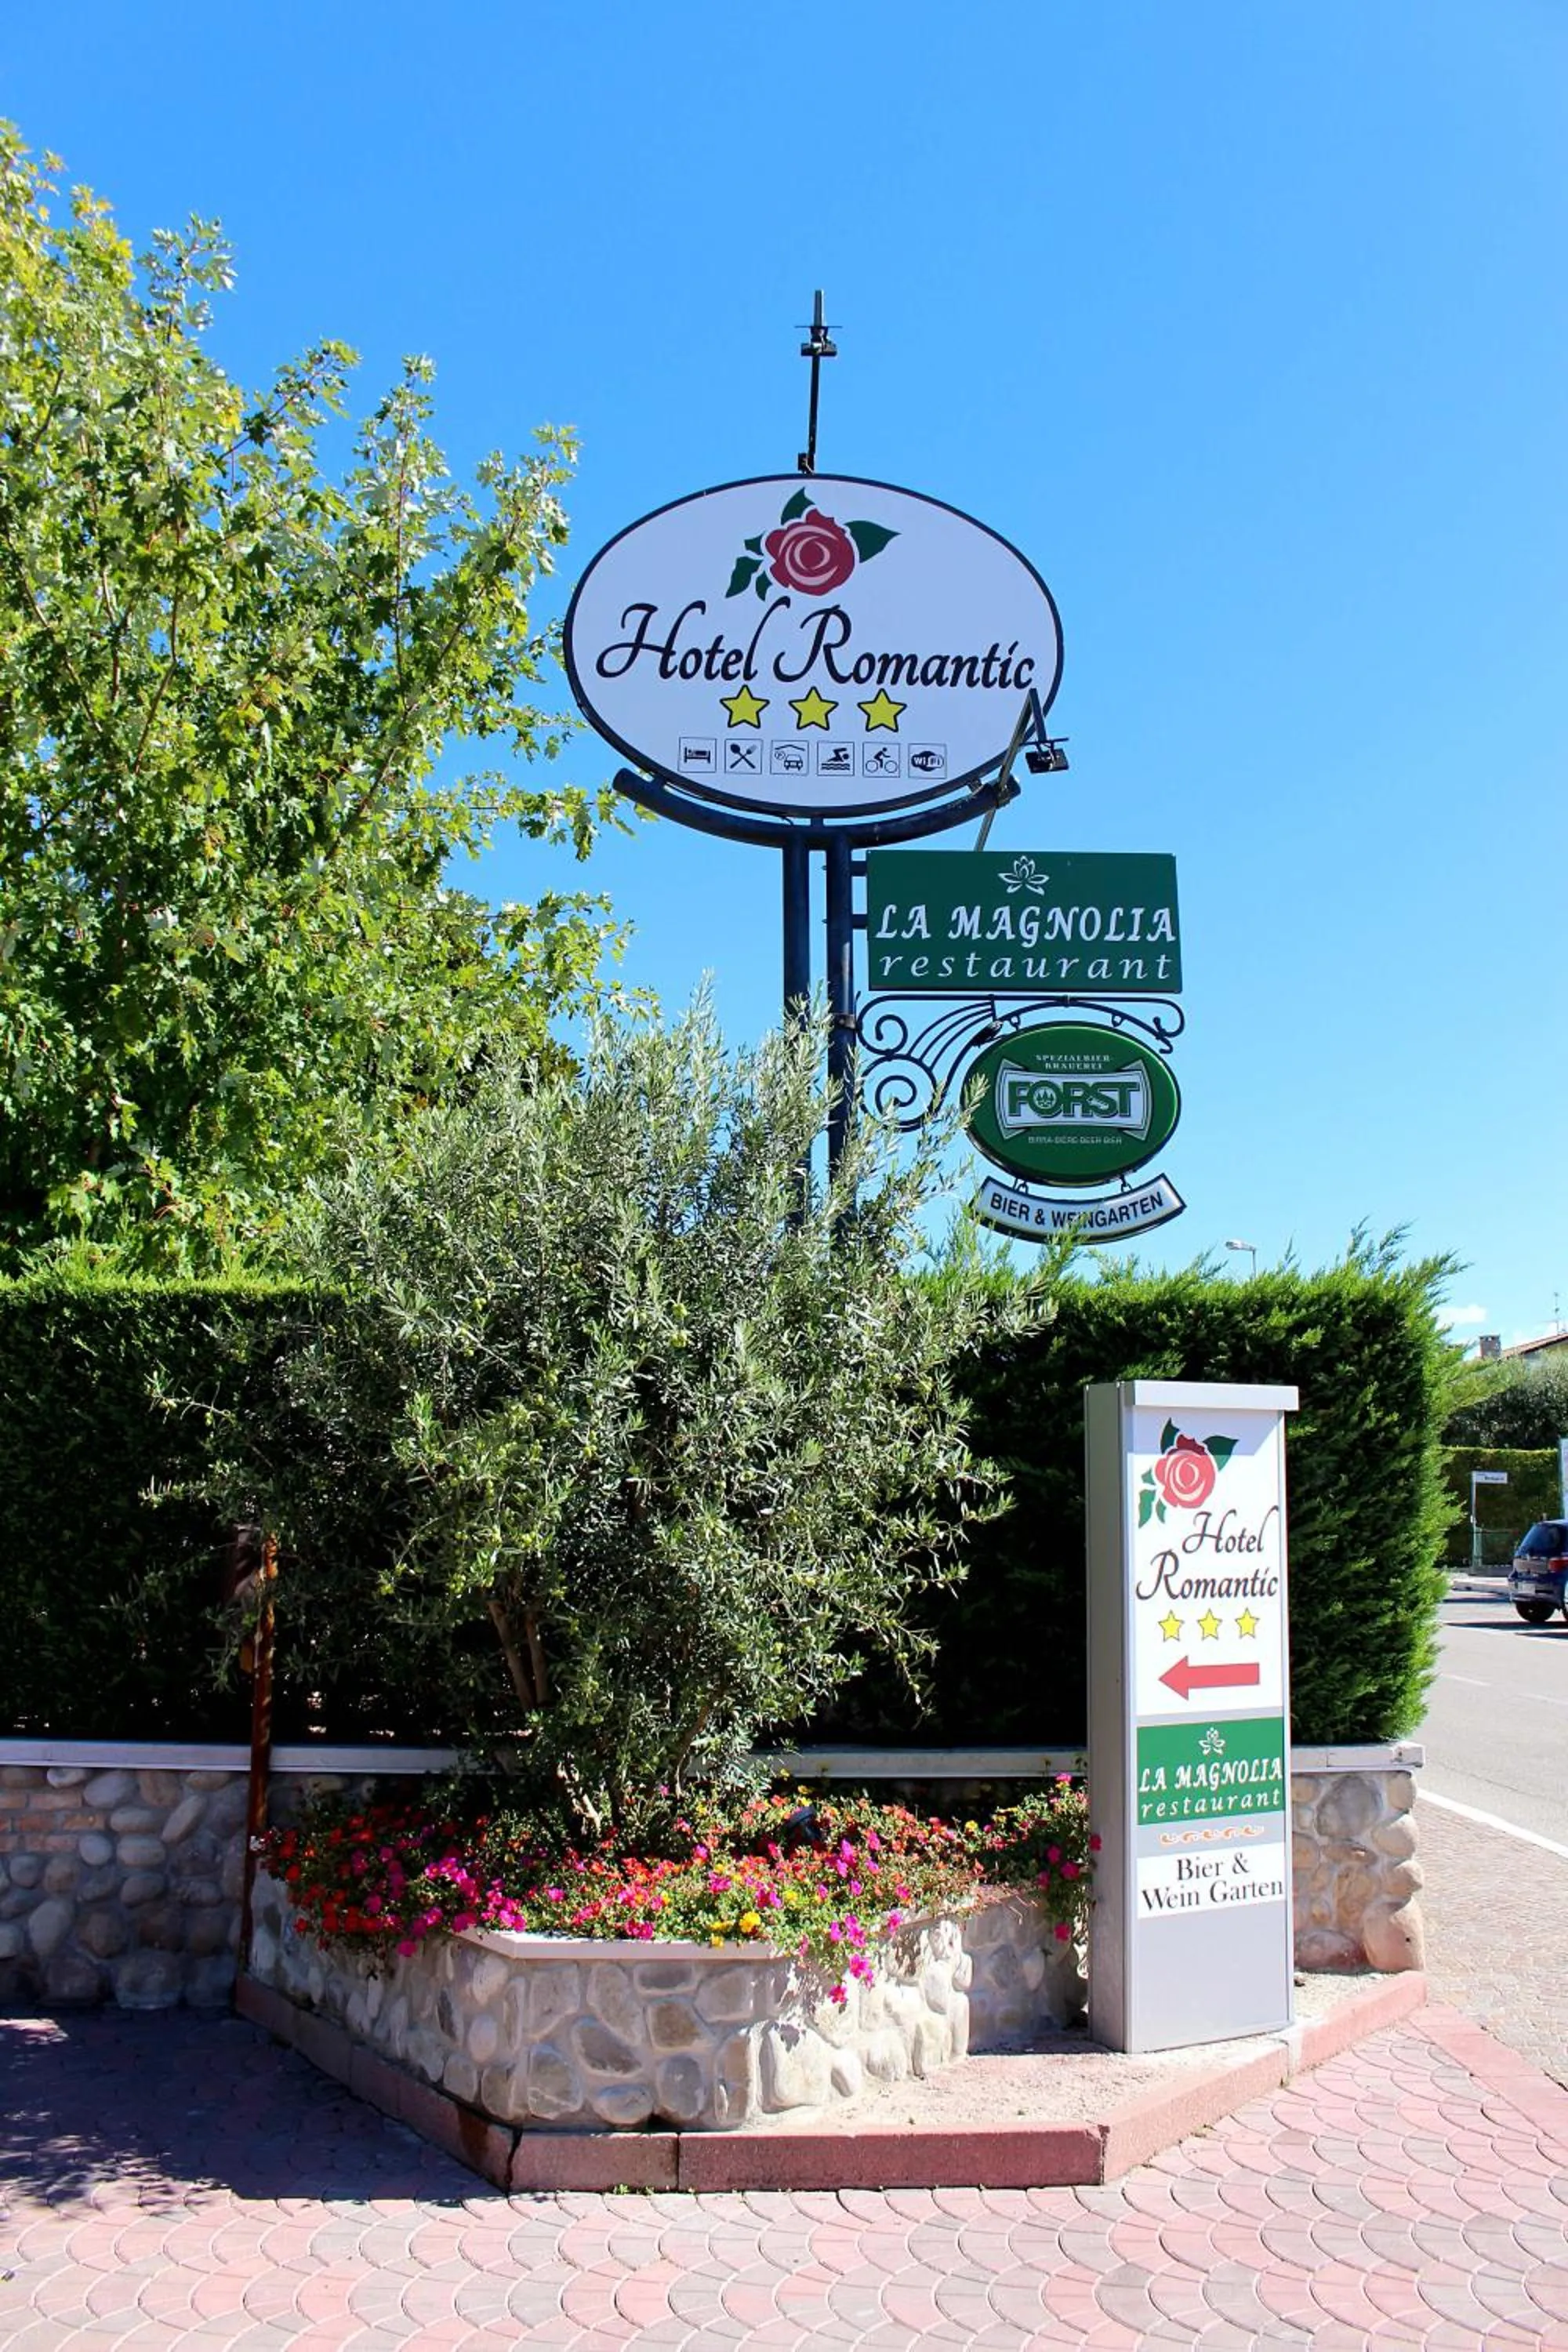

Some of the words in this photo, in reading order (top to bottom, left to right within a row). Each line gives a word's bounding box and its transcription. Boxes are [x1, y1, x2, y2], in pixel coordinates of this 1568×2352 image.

[595, 595, 791, 681] Hotel
[876, 904, 931, 939] LA
[947, 905, 1176, 948] MAGNOLIA
[879, 952, 1174, 979] restaurant
[1007, 1080, 1140, 1118] FORST
[990, 1192, 1030, 1221] BIER
[1034, 1208, 1045, 1225] &
[1181, 1505, 1279, 1555] Hotel
[1138, 1767, 1167, 1793] LA
[1174, 1757, 1283, 1791] MAGNOLIA
[1141, 1788, 1281, 1819] restaurant
[1177, 1856, 1225, 1882] Bier
[1232, 1852, 1250, 1875] &
[1142, 1885, 1200, 1911] Wein
[1210, 1879, 1283, 1904] Garten
